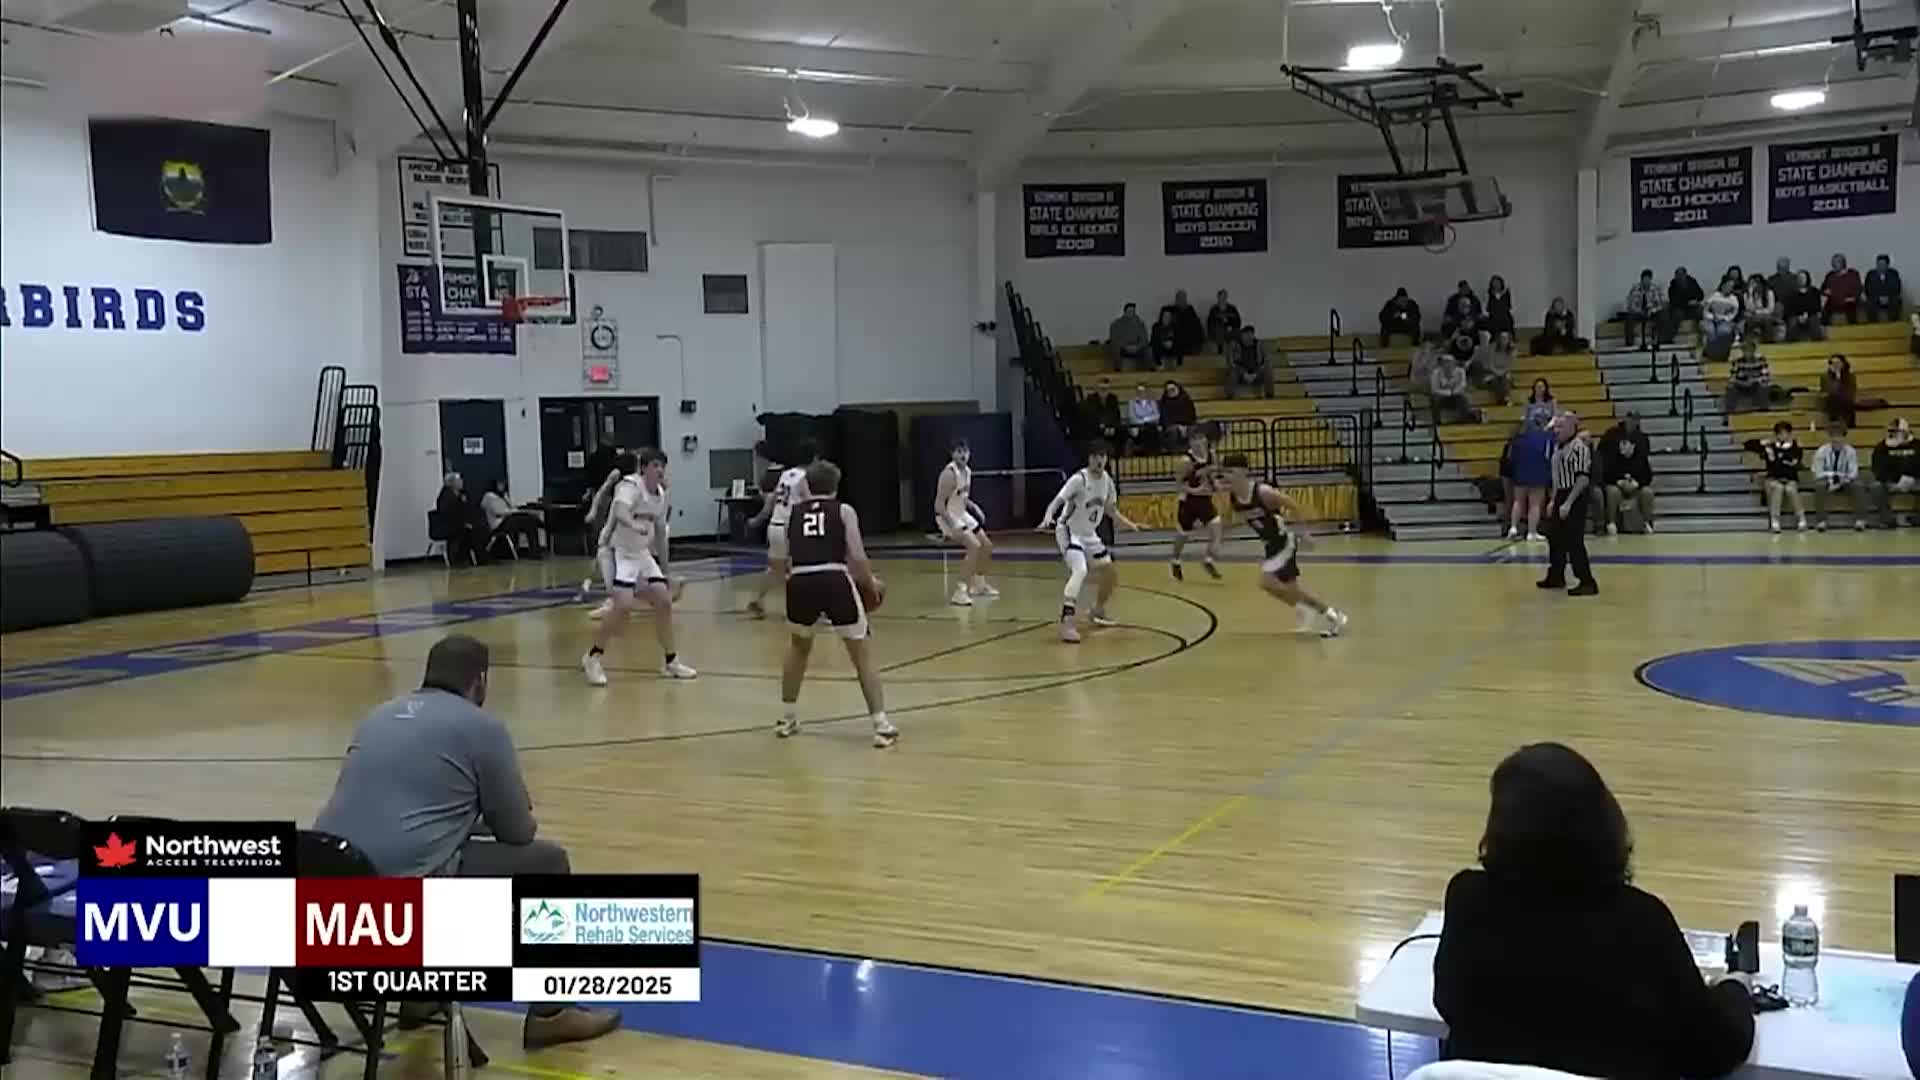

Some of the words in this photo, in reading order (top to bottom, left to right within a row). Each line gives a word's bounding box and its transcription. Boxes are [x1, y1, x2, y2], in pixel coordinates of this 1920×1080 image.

[1778, 165, 1816, 183] STATE
[1818, 158, 1888, 178] CHAMPIONS
[1639, 176, 1676, 194] STATE
[1679, 171, 1744, 191] CHAMPIONS
[1775, 184, 1806, 199] BOYS
[1808, 178, 1889, 196] BASKETBALL
[1641, 194, 1682, 209] FIELD
[1684, 191, 1741, 205] HOCKEY
[1812, 199, 1851, 212] 2011
[1029, 205, 1063, 221] STATE
[1064, 205, 1120, 221] CHAMPIONS
[1171, 203, 1202, 219] STATE
[1203, 201, 1259, 218] CHAMPIONS
[1673, 209, 1709, 223] 2011
[1199, 235, 1234, 249] 2010
[1373, 228, 1410, 241] 2010
[1, 283, 205, 332] BIRDS
[803, 512, 825, 536] 21
